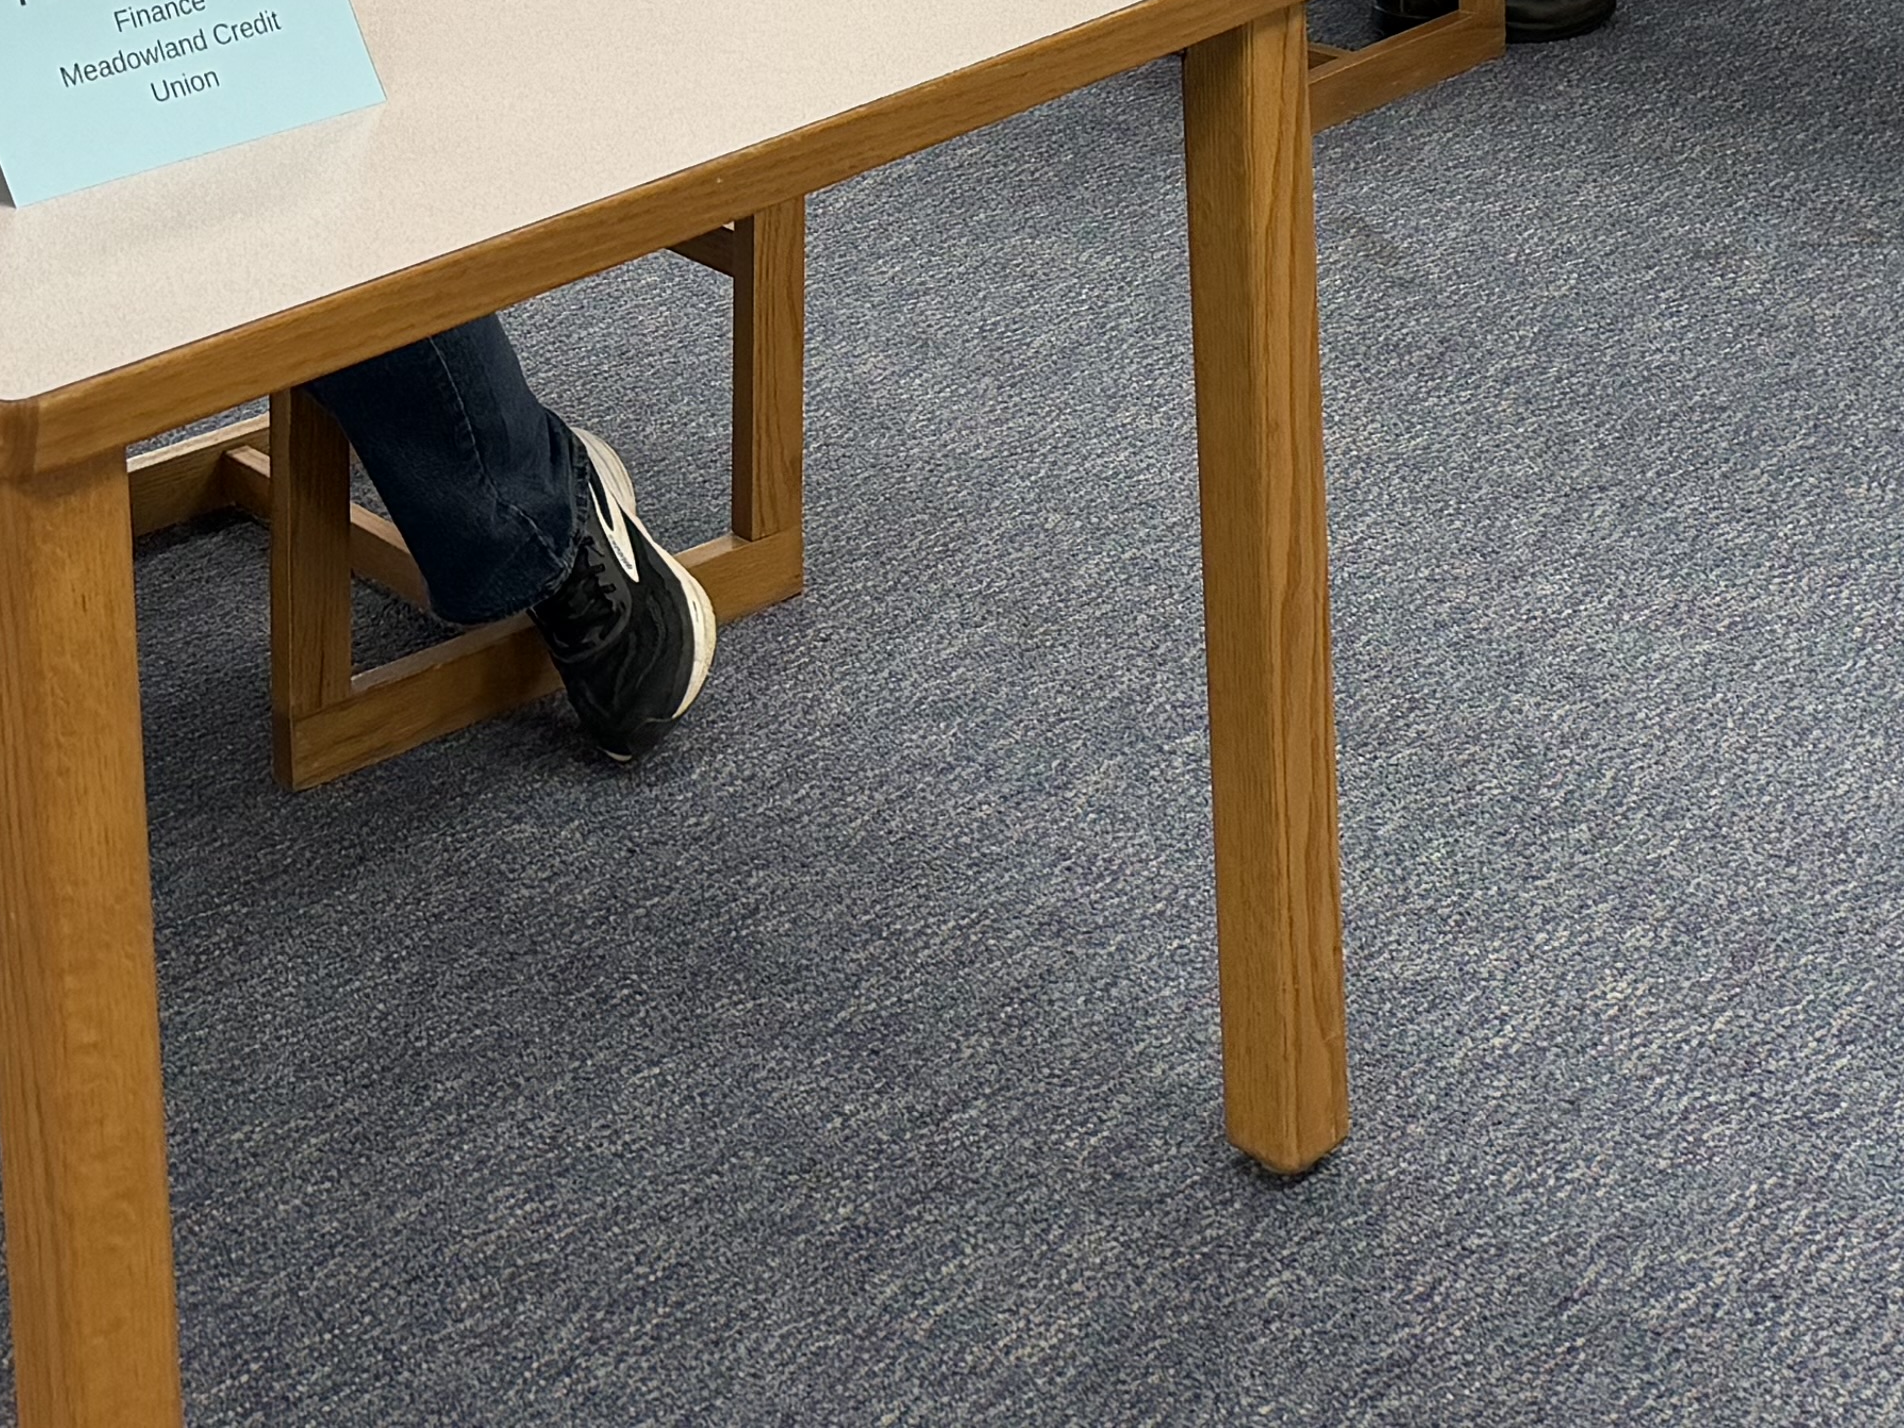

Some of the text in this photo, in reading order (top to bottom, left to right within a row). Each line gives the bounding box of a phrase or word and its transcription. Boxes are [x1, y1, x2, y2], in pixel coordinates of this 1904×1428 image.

[59, 8, 282, 89] Meadowland Credit
[150, 66, 220, 104] Union
